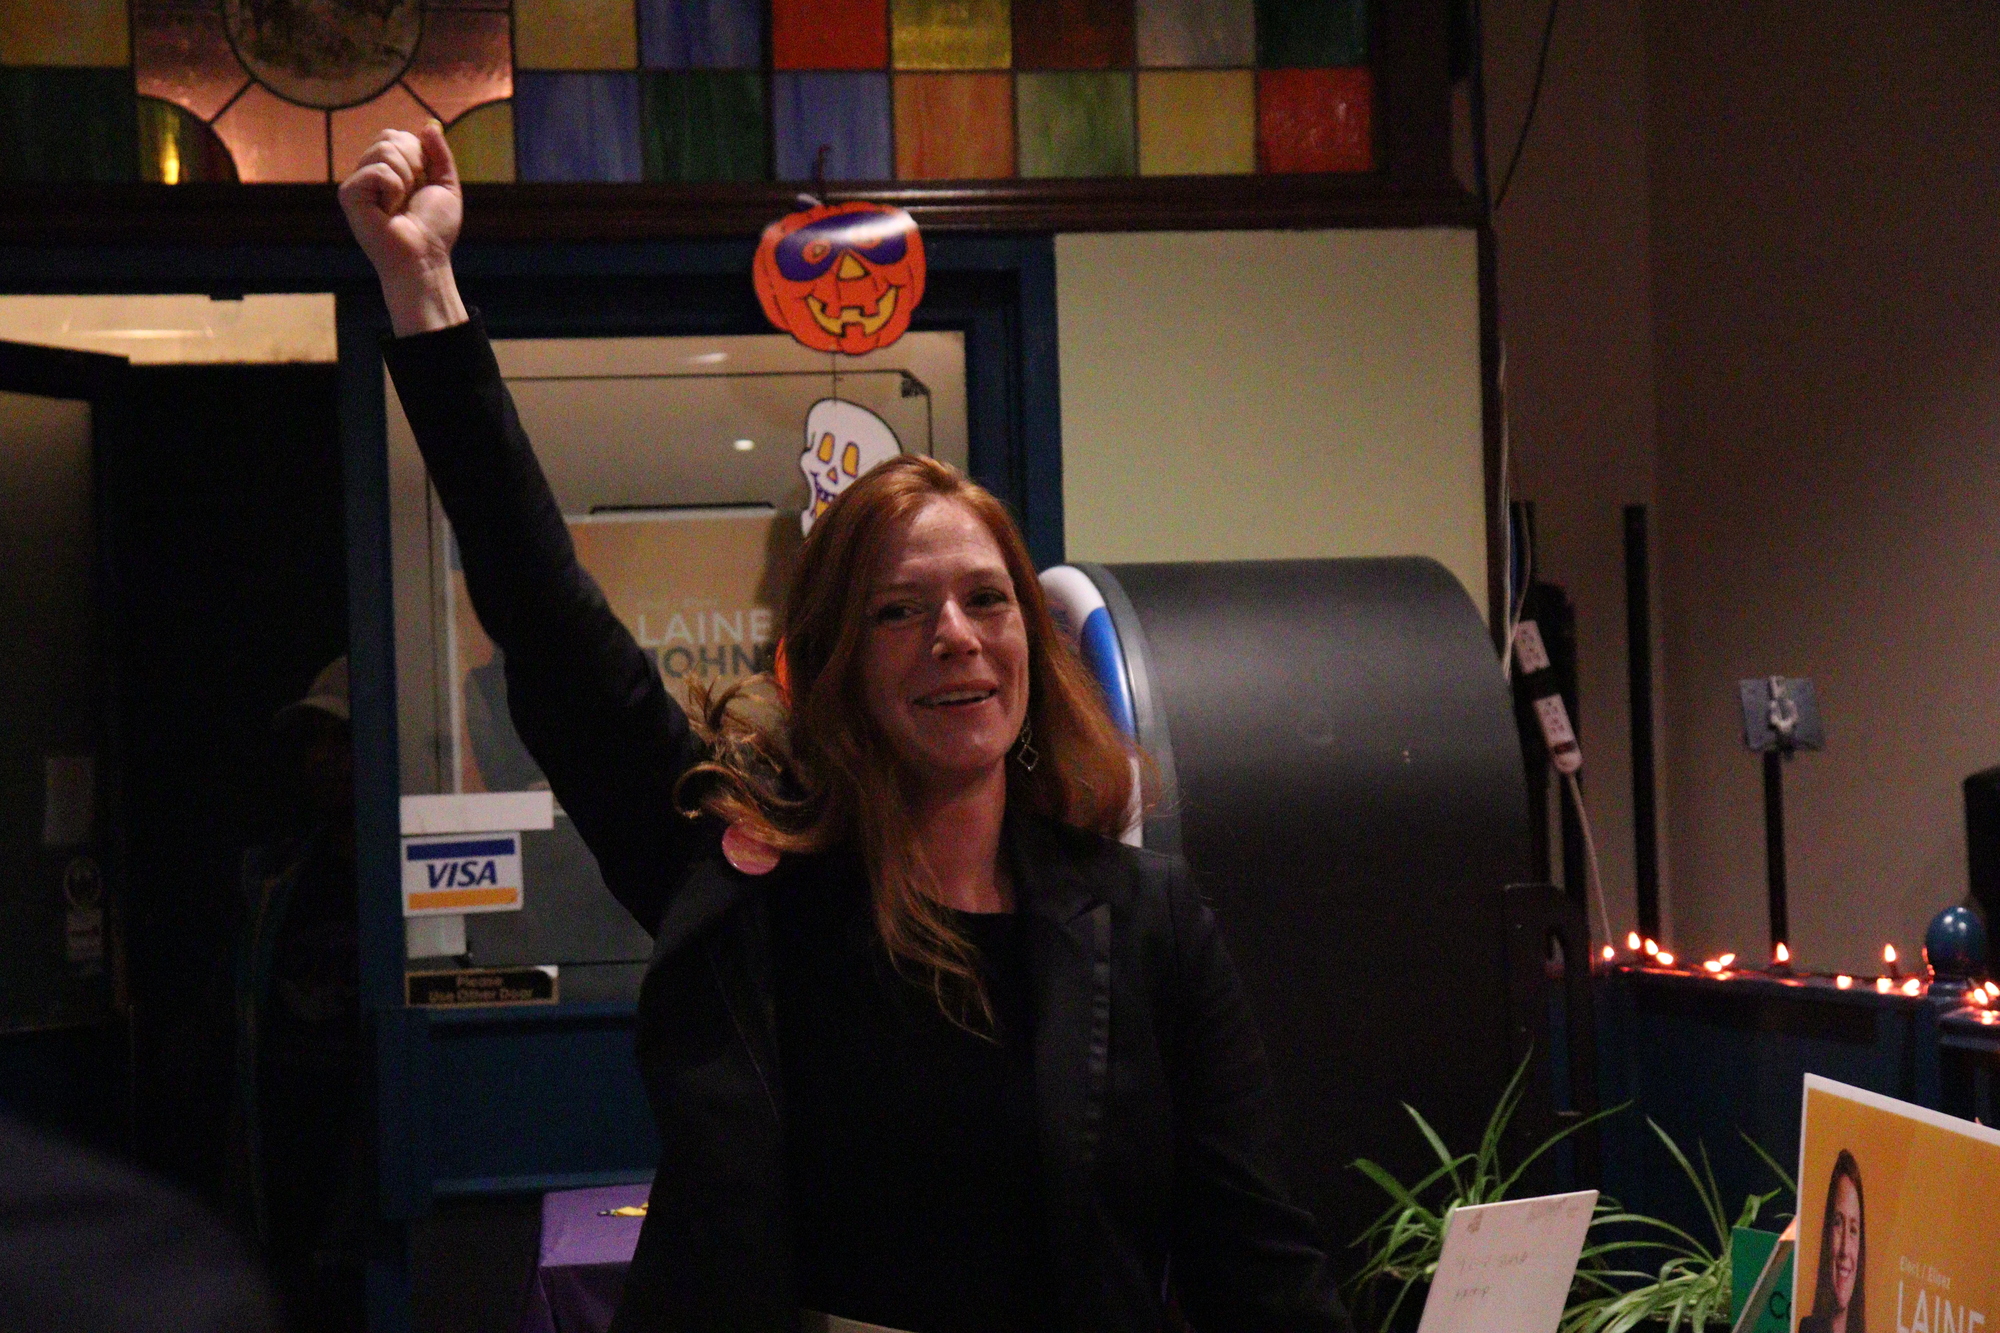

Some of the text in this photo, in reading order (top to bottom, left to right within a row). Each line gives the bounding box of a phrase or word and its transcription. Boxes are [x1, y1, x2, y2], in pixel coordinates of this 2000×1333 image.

[637, 608, 773, 646] LAINE
[652, 643, 762, 679] OHN
[427, 860, 498, 889] VISA
